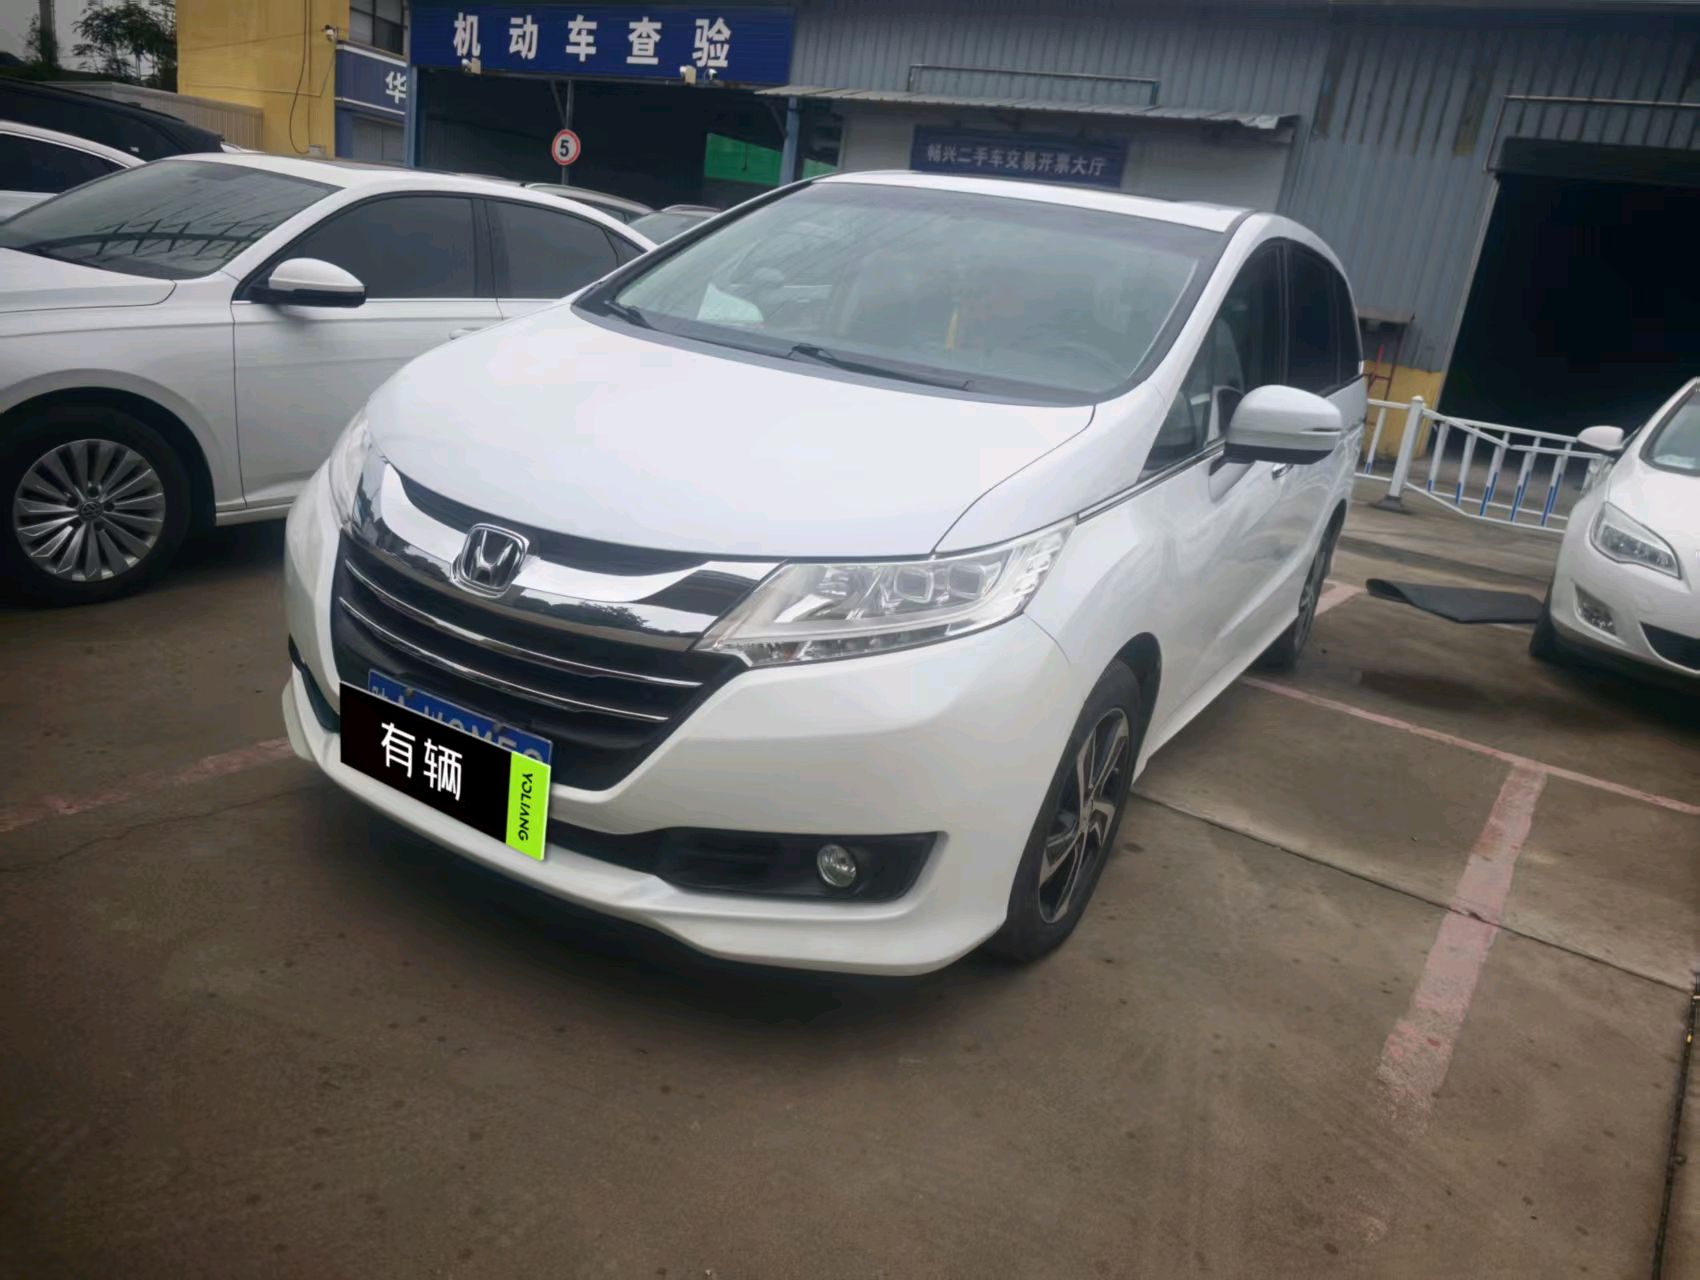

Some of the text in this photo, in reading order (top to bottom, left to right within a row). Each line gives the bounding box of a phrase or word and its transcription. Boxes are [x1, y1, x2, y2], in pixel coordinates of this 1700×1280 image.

[453, 12, 733, 68] 机动车查验
[384, 71, 407, 104] 华
[558, 139, 571, 158] 5
[927, 143, 1105, 176] 畅兴二手车交易开票大厅
